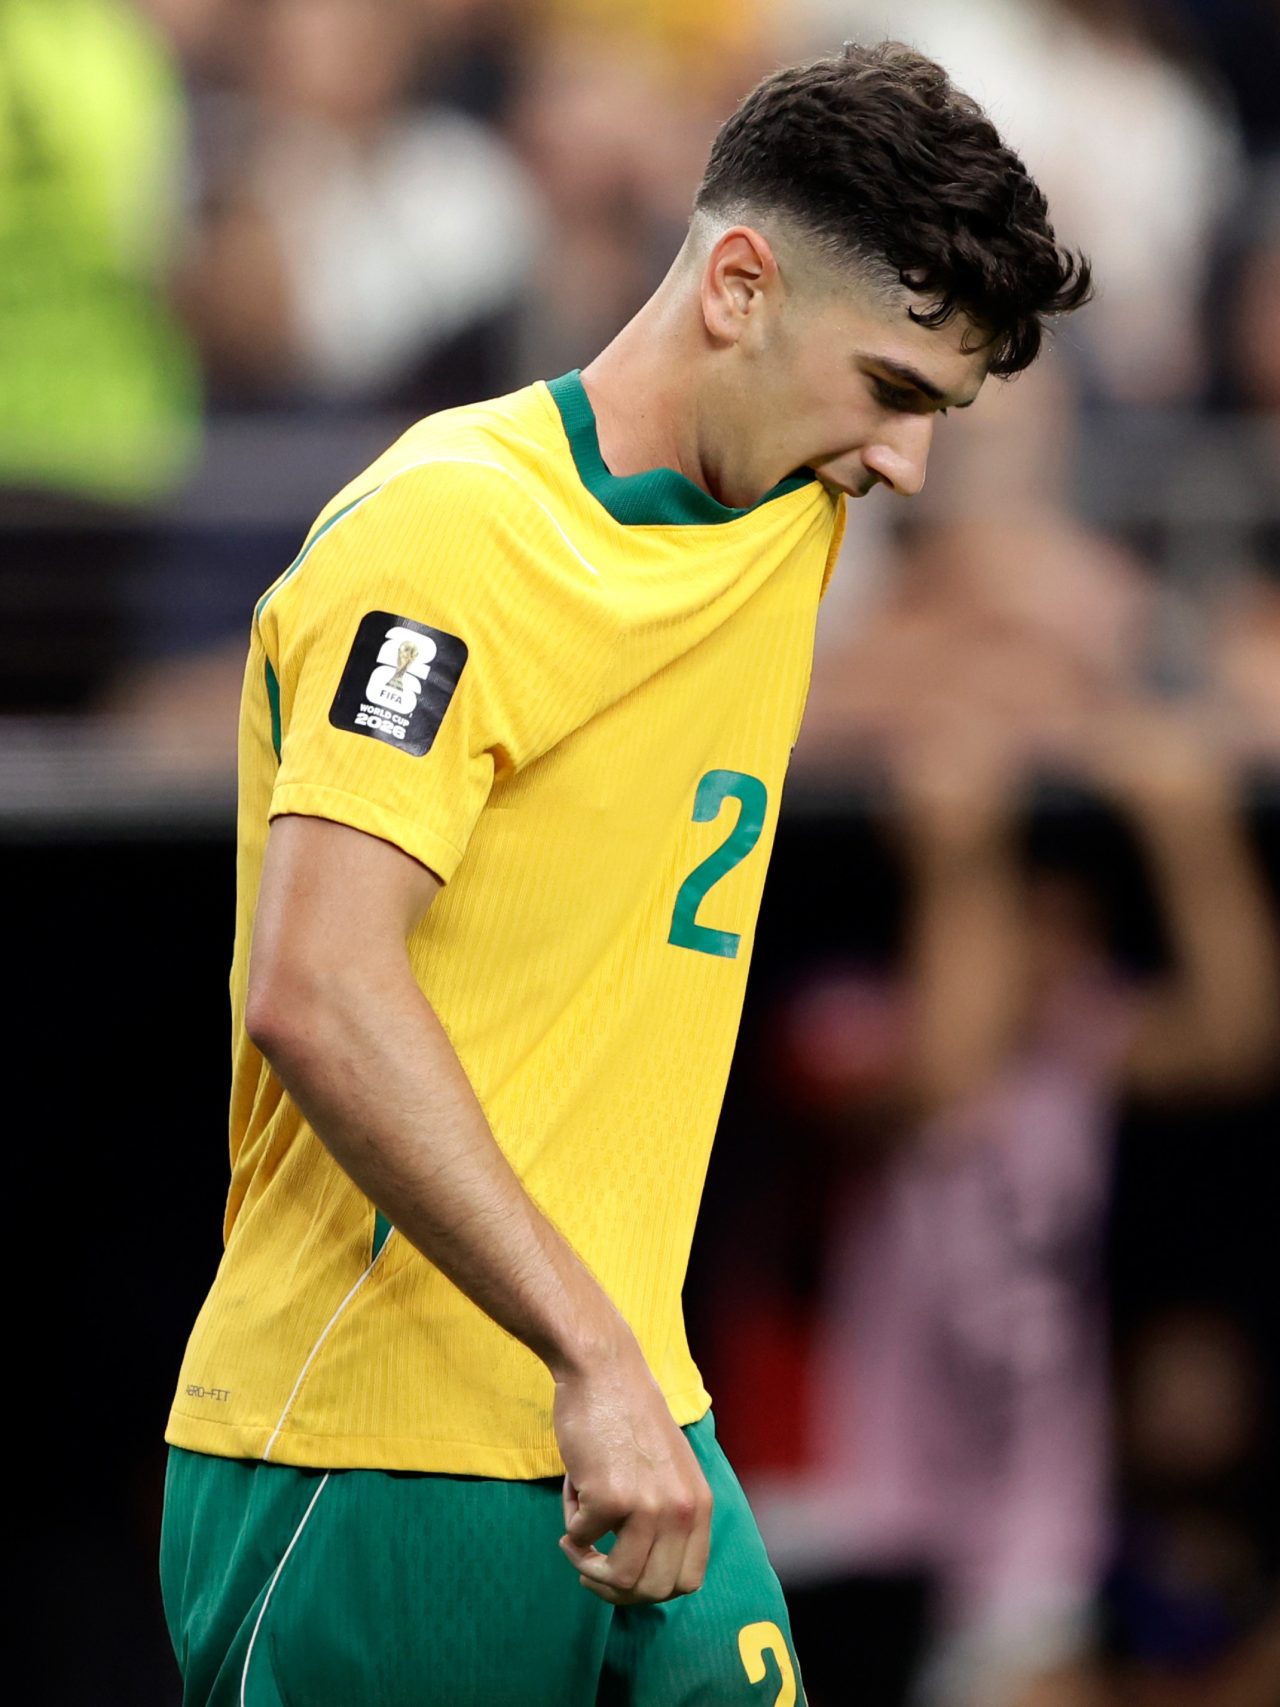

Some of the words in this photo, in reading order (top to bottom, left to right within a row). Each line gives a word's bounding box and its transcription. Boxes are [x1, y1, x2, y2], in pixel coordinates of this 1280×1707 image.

[379, 689, 402, 704] FIFA
[354, 713, 406, 740] 2026
[360, 703, 391, 720] WORLD
[392, 714, 410, 727] CUP
[667, 769, 767, 959] 2
